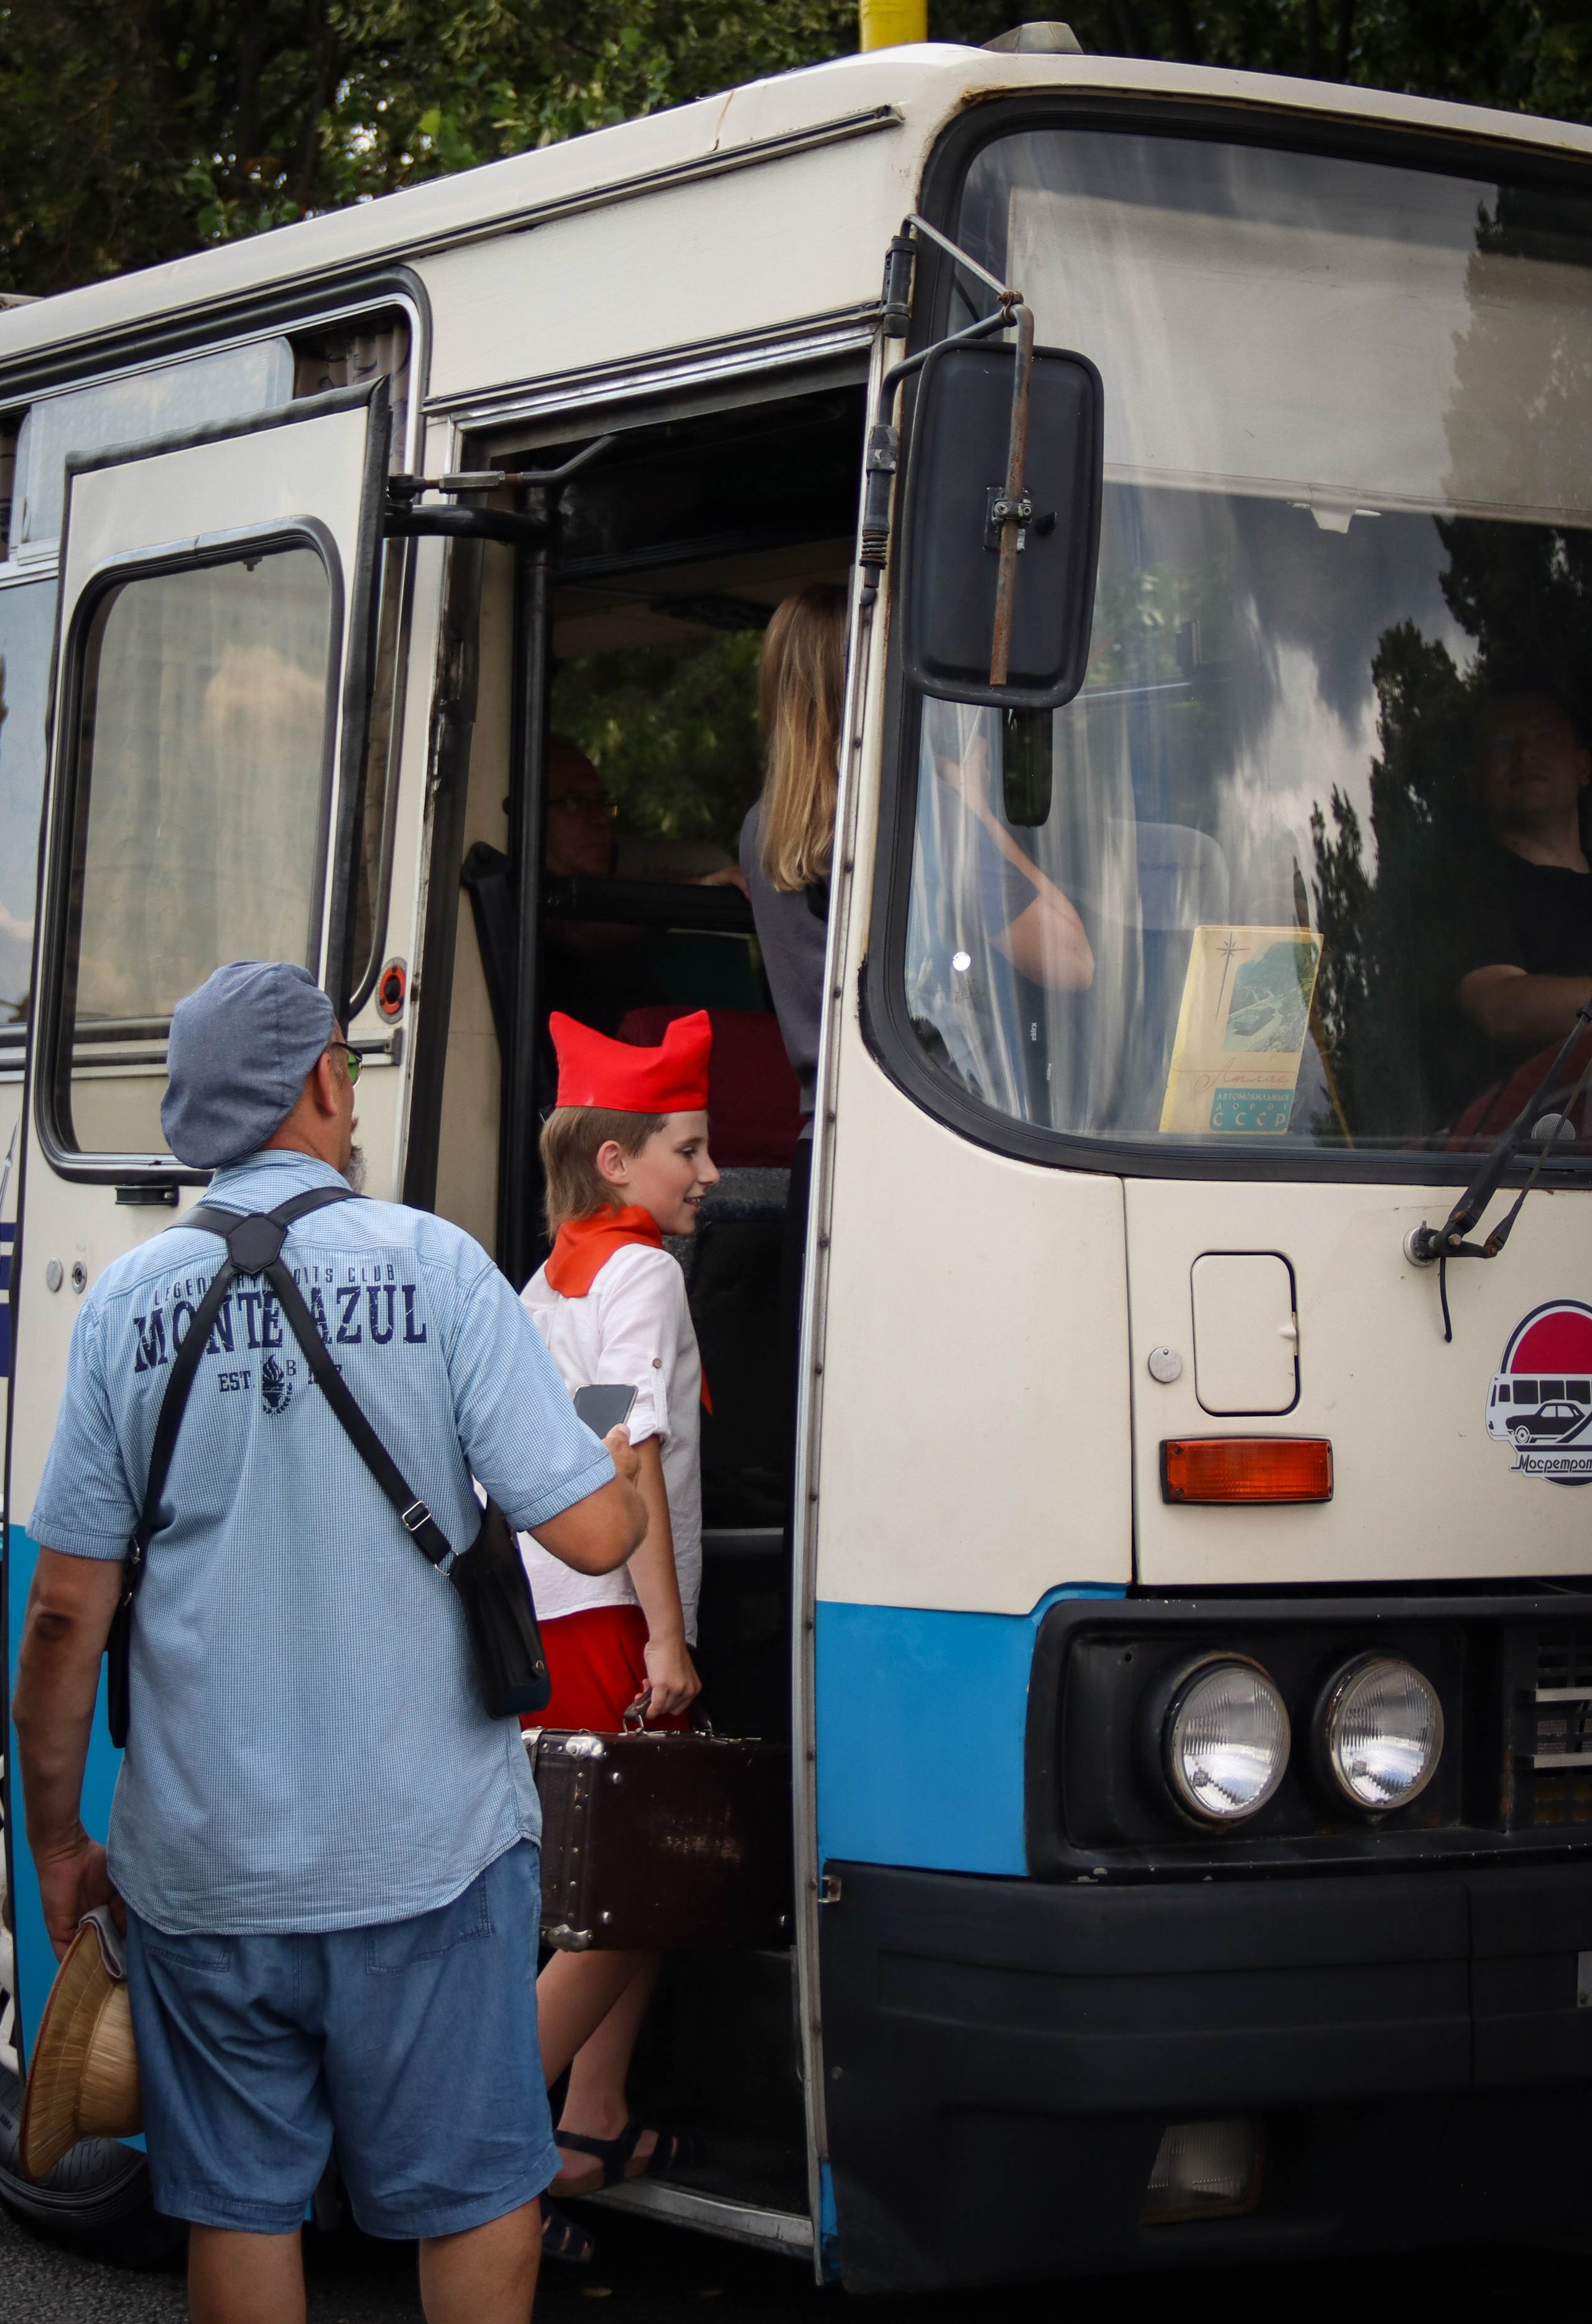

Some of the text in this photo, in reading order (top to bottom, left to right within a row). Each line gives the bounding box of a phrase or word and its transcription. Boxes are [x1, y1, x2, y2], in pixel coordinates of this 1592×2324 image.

[1218, 1092, 1289, 1101] АВТОМОБИЛЬНЫХ
[1213, 1112, 1286, 1127] СССР
[348, 1264, 394, 1282] CLUB
[134, 1284, 427, 1372] MONTE AZUL
